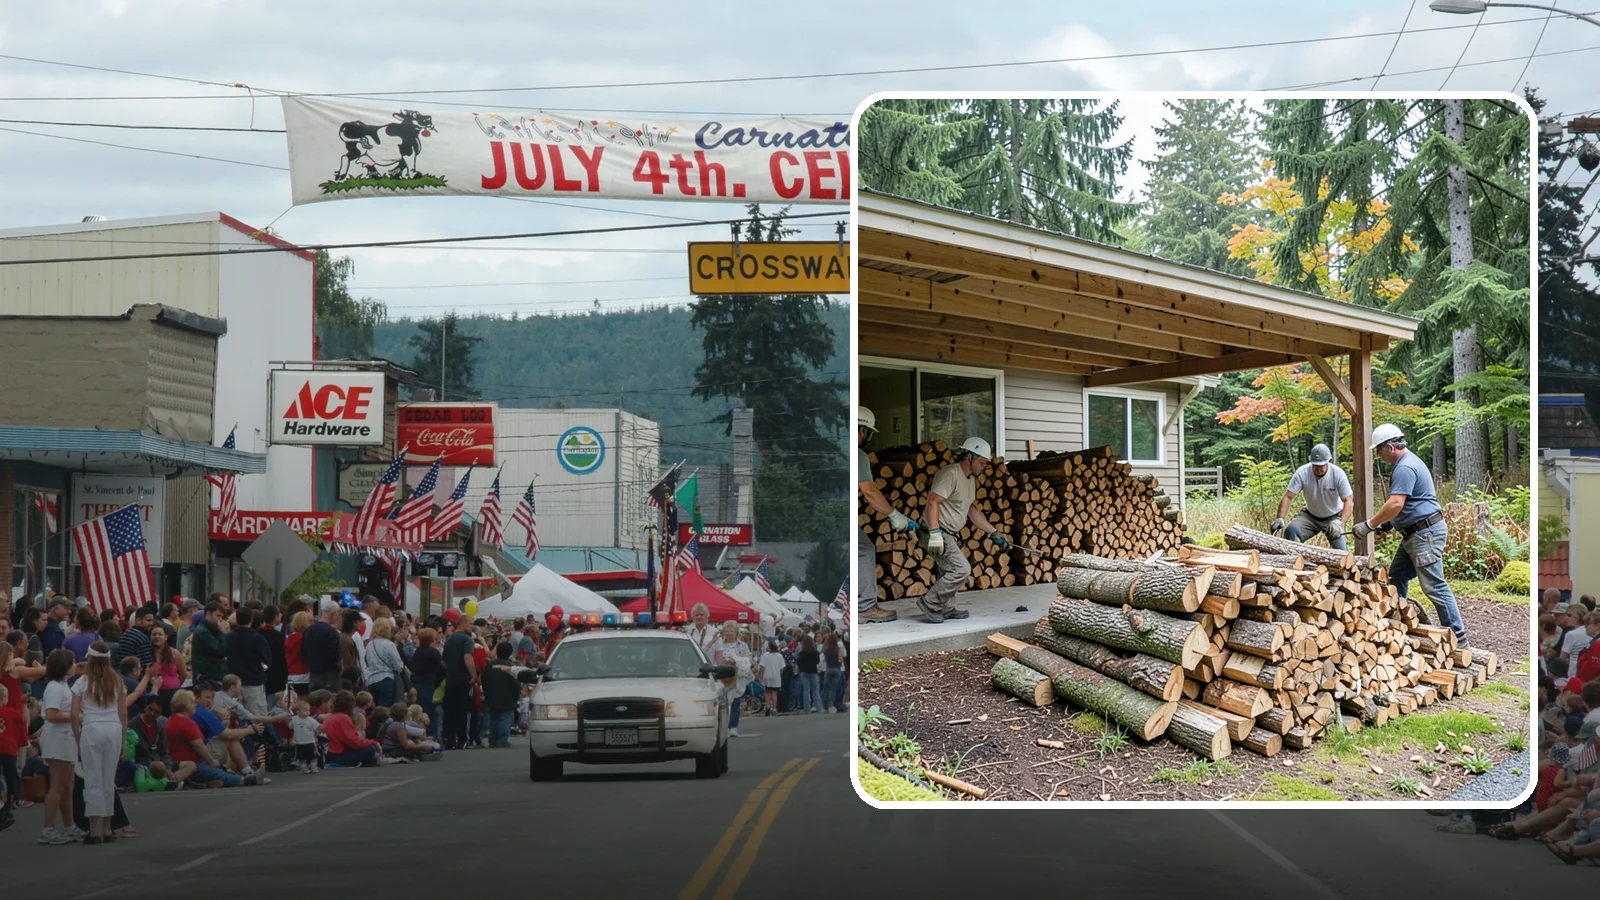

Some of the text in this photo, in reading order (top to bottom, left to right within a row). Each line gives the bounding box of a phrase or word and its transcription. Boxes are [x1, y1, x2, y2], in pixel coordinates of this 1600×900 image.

[695, 121, 850, 150] Carnat
[481, 141, 605, 193] JULY
[632, 150, 746, 198] 4th.
[696, 254, 850, 280] CROSSWA
[283, 380, 373, 420] ACE
[405, 409, 485, 423] CEDAR LOG
[283, 421, 370, 436] Hardware
[416, 428, 477, 447] Coca-Cola
[353, 467, 387, 480] Simpl
[95, 485, 124, 495] Vincent
[126, 486, 135, 495] de
[137, 486, 155, 495] Paul
[688, 526, 741, 535] CRNATION
[699, 535, 730, 543] GLASS
